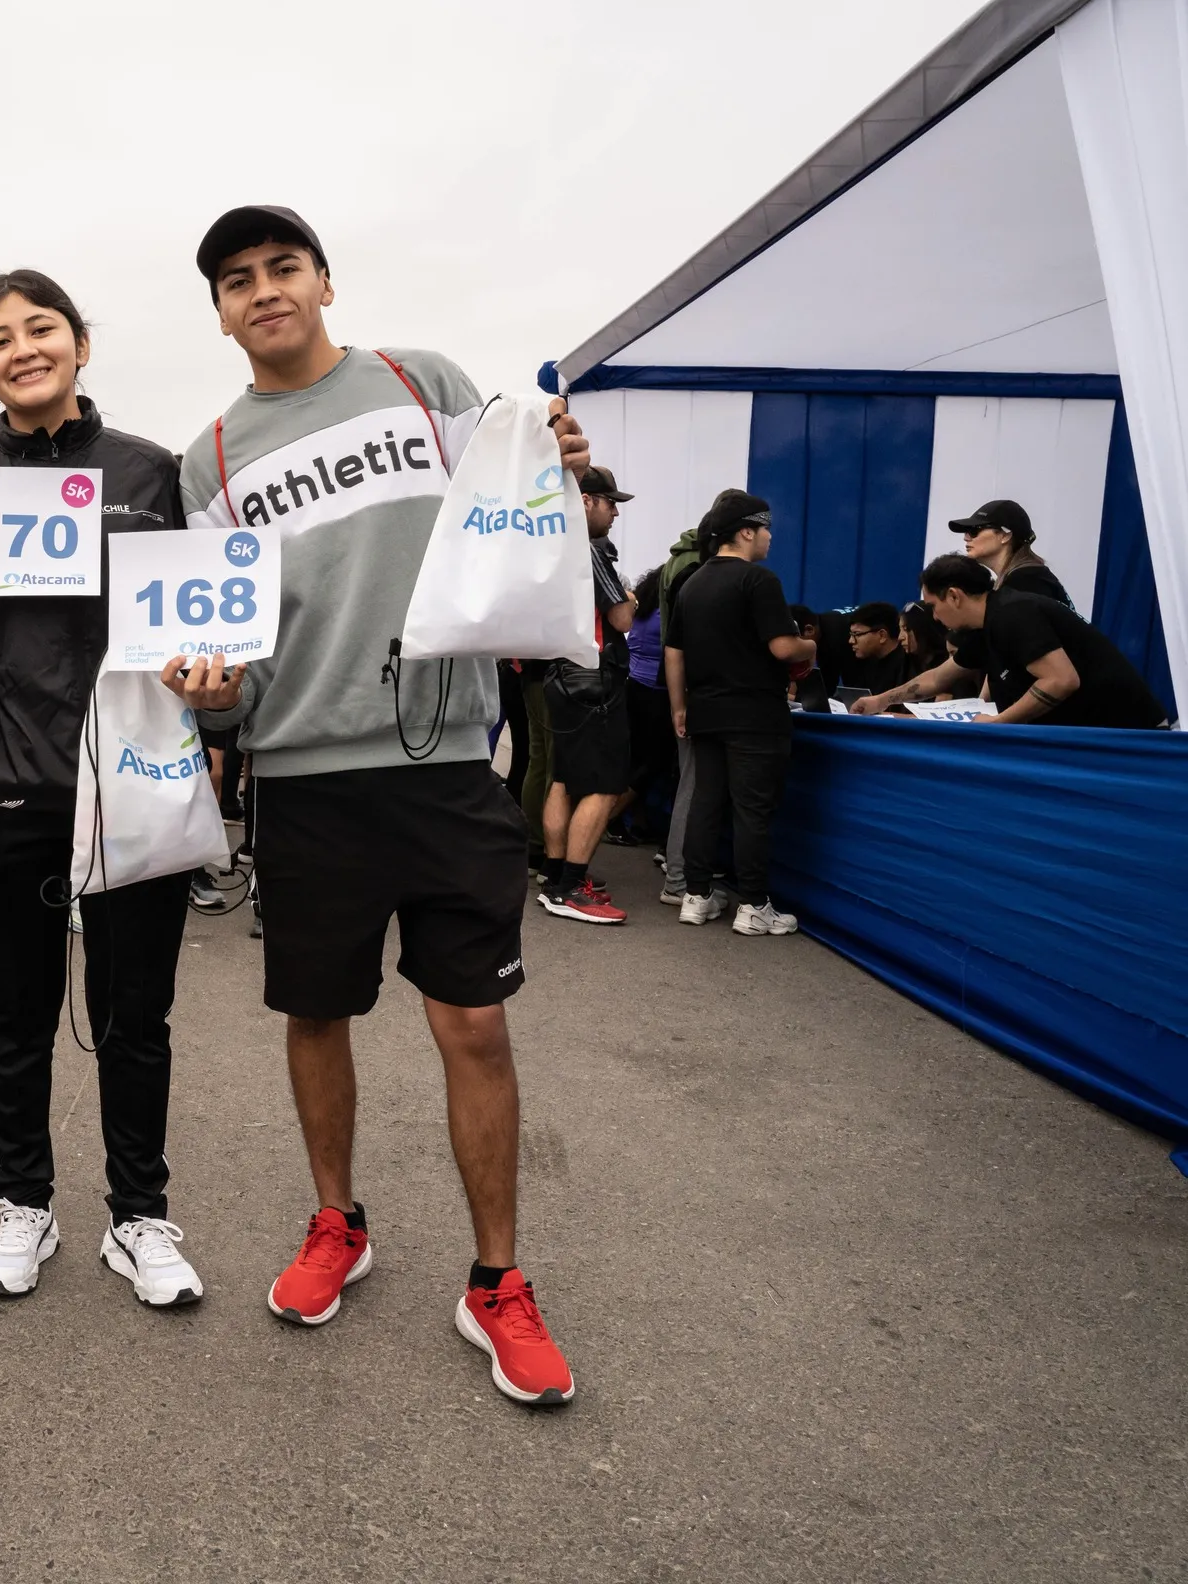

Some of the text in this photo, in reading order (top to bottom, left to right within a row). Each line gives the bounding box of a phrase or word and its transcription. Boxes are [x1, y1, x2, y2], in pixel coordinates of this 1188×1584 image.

[242, 430, 431, 527] Athletic
[65, 482, 90, 501] 5K
[463, 506, 566, 537] Atacam
[230, 541, 256, 559] 5K
[20, 573, 86, 585] Atacama
[136, 577, 258, 627] 168
[197, 640, 263, 655] Atacama
[116, 747, 206, 781] Atacam
